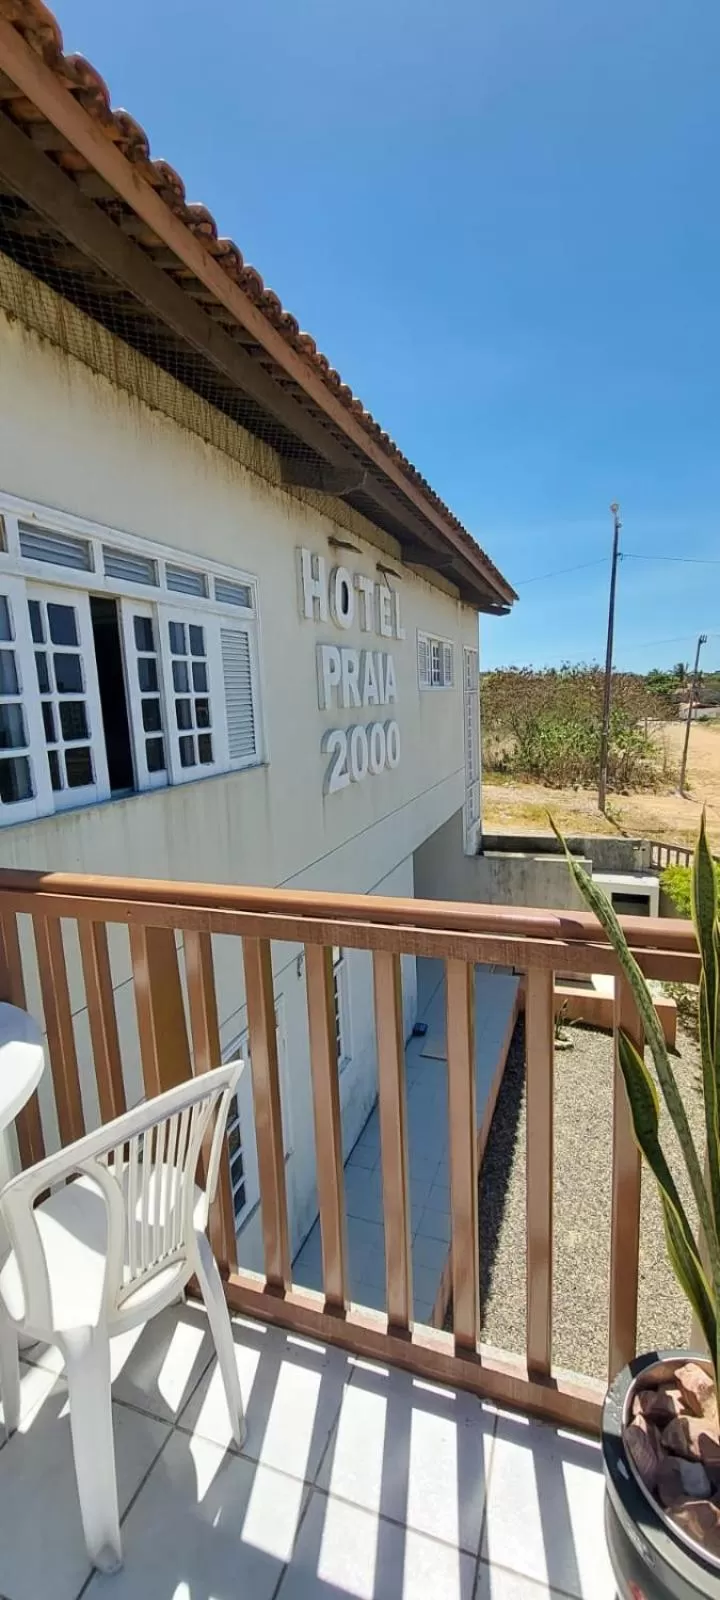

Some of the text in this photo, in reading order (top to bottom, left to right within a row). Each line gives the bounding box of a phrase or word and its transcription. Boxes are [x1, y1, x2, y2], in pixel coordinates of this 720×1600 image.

[298, 547, 406, 640] HOTEL
[317, 643, 397, 710] PRAIA
[321, 719, 400, 794] 2000
